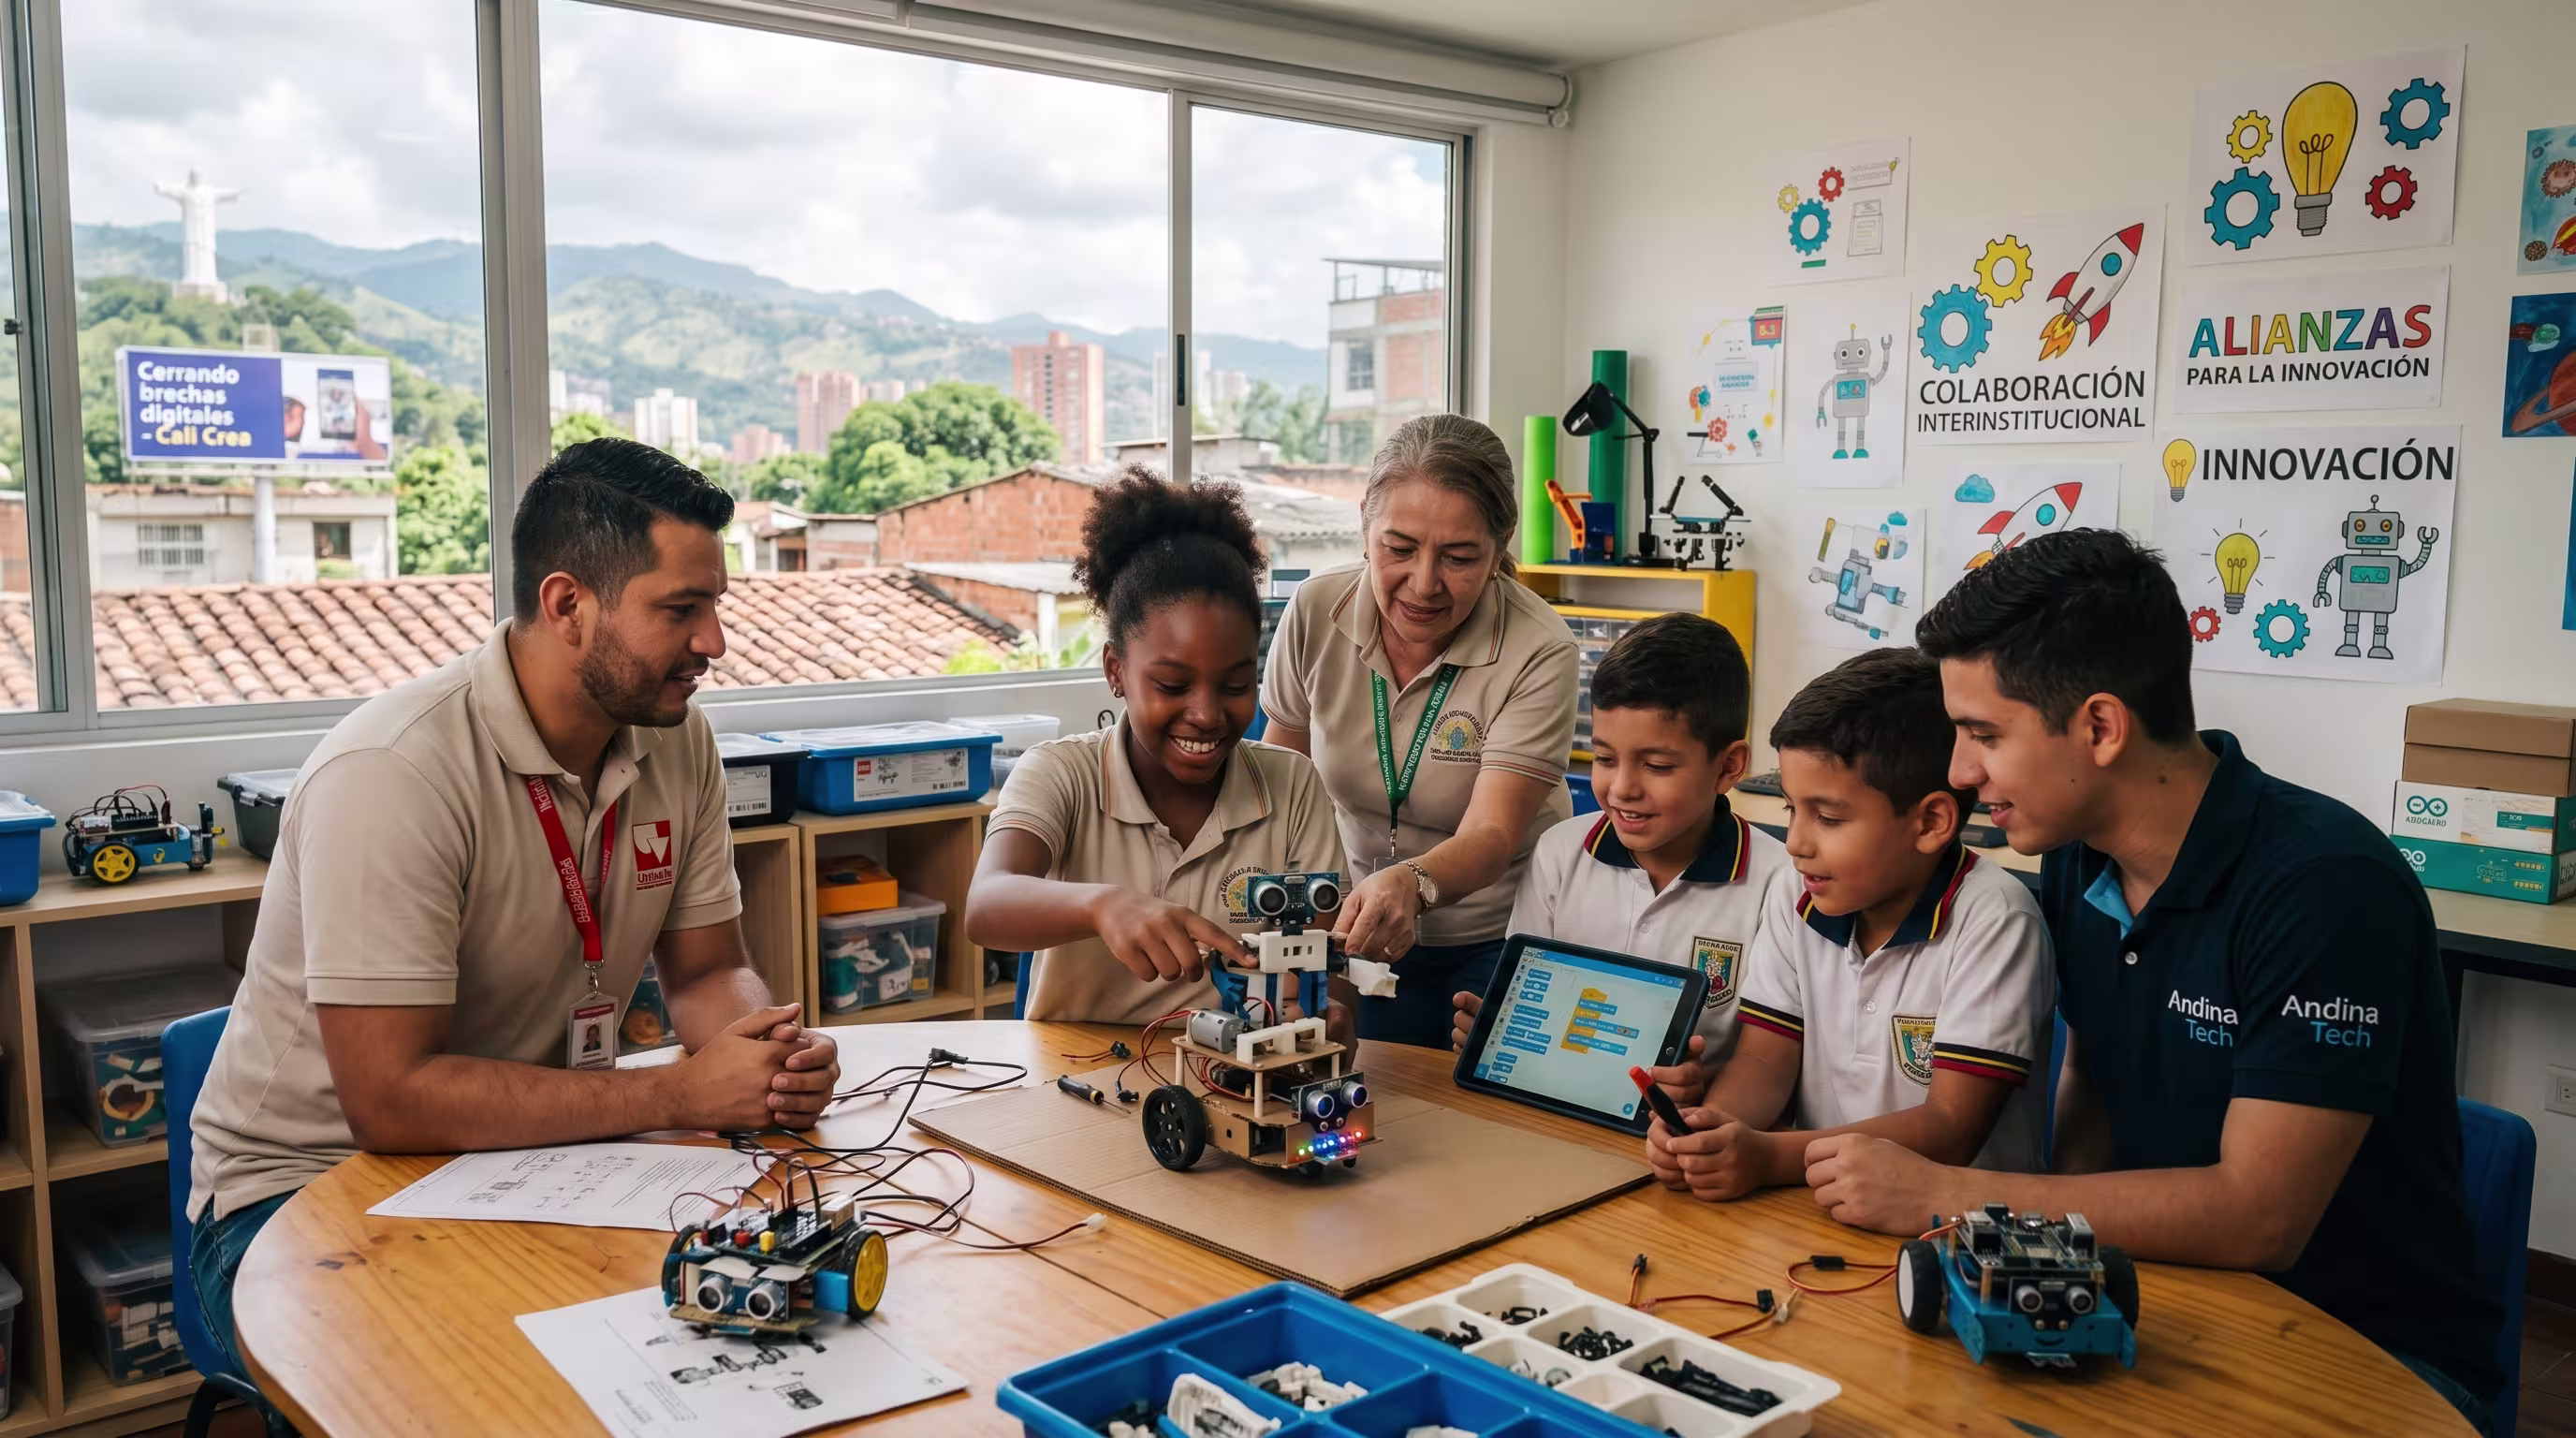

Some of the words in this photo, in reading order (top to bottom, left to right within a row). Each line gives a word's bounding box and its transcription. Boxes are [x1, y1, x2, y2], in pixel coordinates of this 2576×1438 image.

[2188, 304, 2432, 358] ALIANZAS
[137, 360, 241, 385] Cerrando
[1920, 365, 2145, 404] COLABORACIÓN
[2187, 366, 2243, 386] PARA
[2248, 363, 2275, 383] LA
[2281, 354, 2430, 382] INNOVACIÓN
[139, 381, 227, 405] brechas
[139, 403, 235, 429] digitales
[1918, 407, 2146, 433] INTERINSTITUCIONAL
[202, 426, 253, 448] Crea
[2203, 438, 2454, 480] INNOVACIÓN
[2168, 990, 2239, 1025] Andina
[2281, 994, 2379, 1025] Andina
[2185, 1018, 2233, 1048] Tech
[2310, 1021, 2371, 1048] Tech
